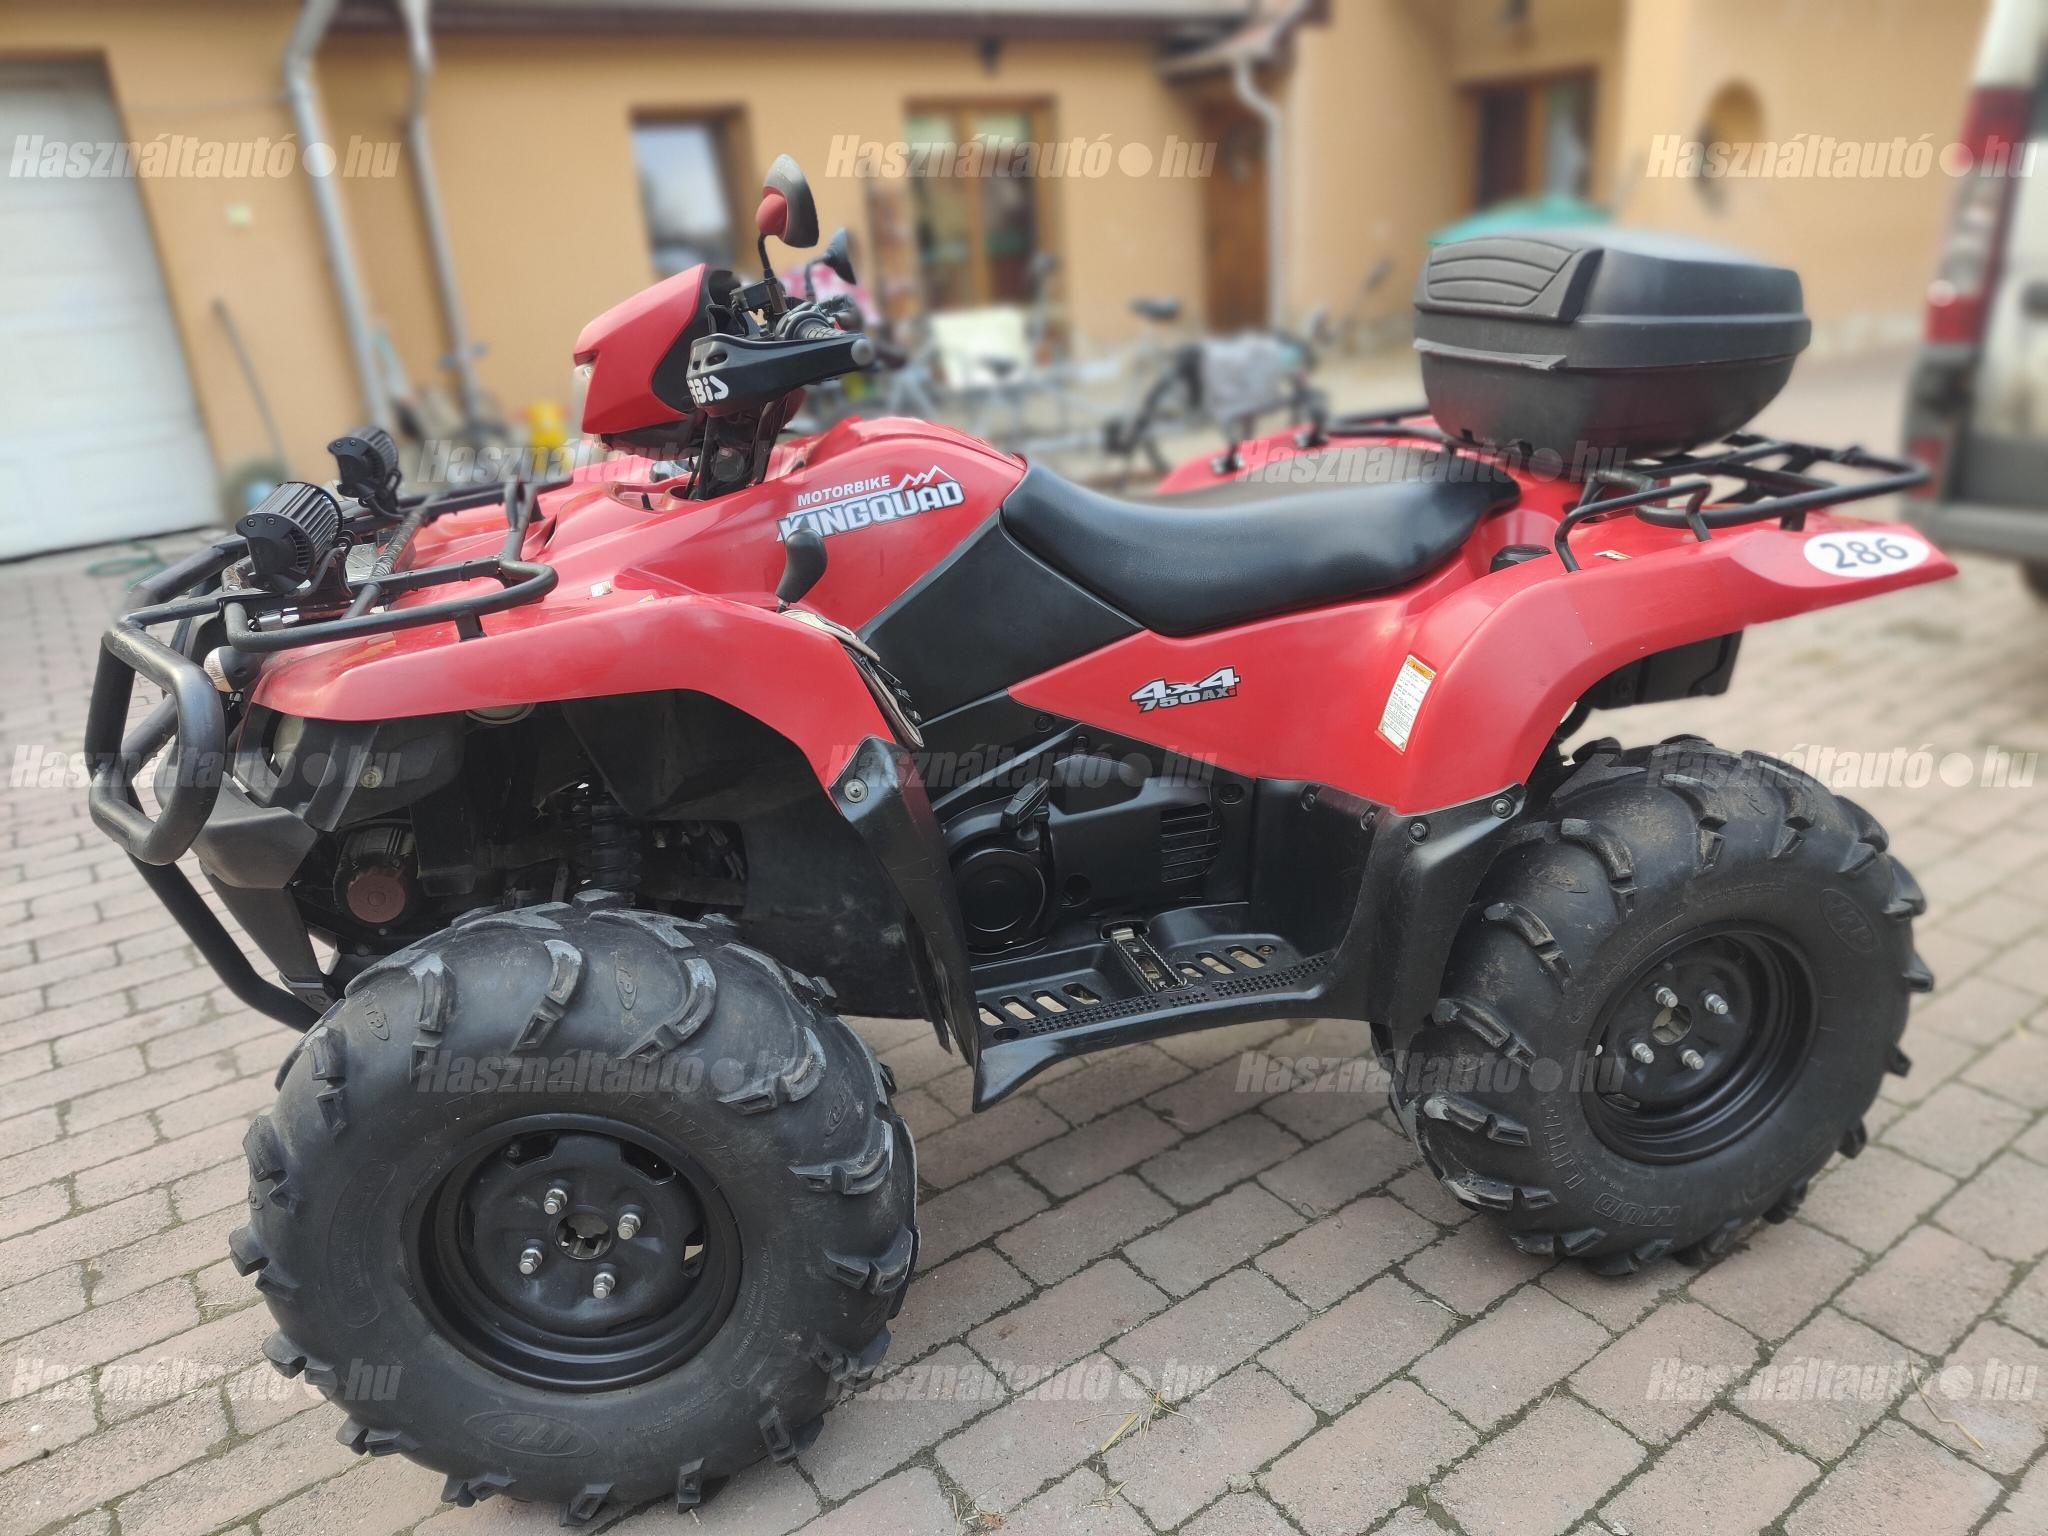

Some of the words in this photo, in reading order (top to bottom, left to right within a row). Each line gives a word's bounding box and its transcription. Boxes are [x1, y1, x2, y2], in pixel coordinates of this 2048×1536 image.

[797, 475, 891, 507] MOTORBIKE
[776, 480, 966, 541] KINGQUAD
[1819, 537, 1909, 569] 286
